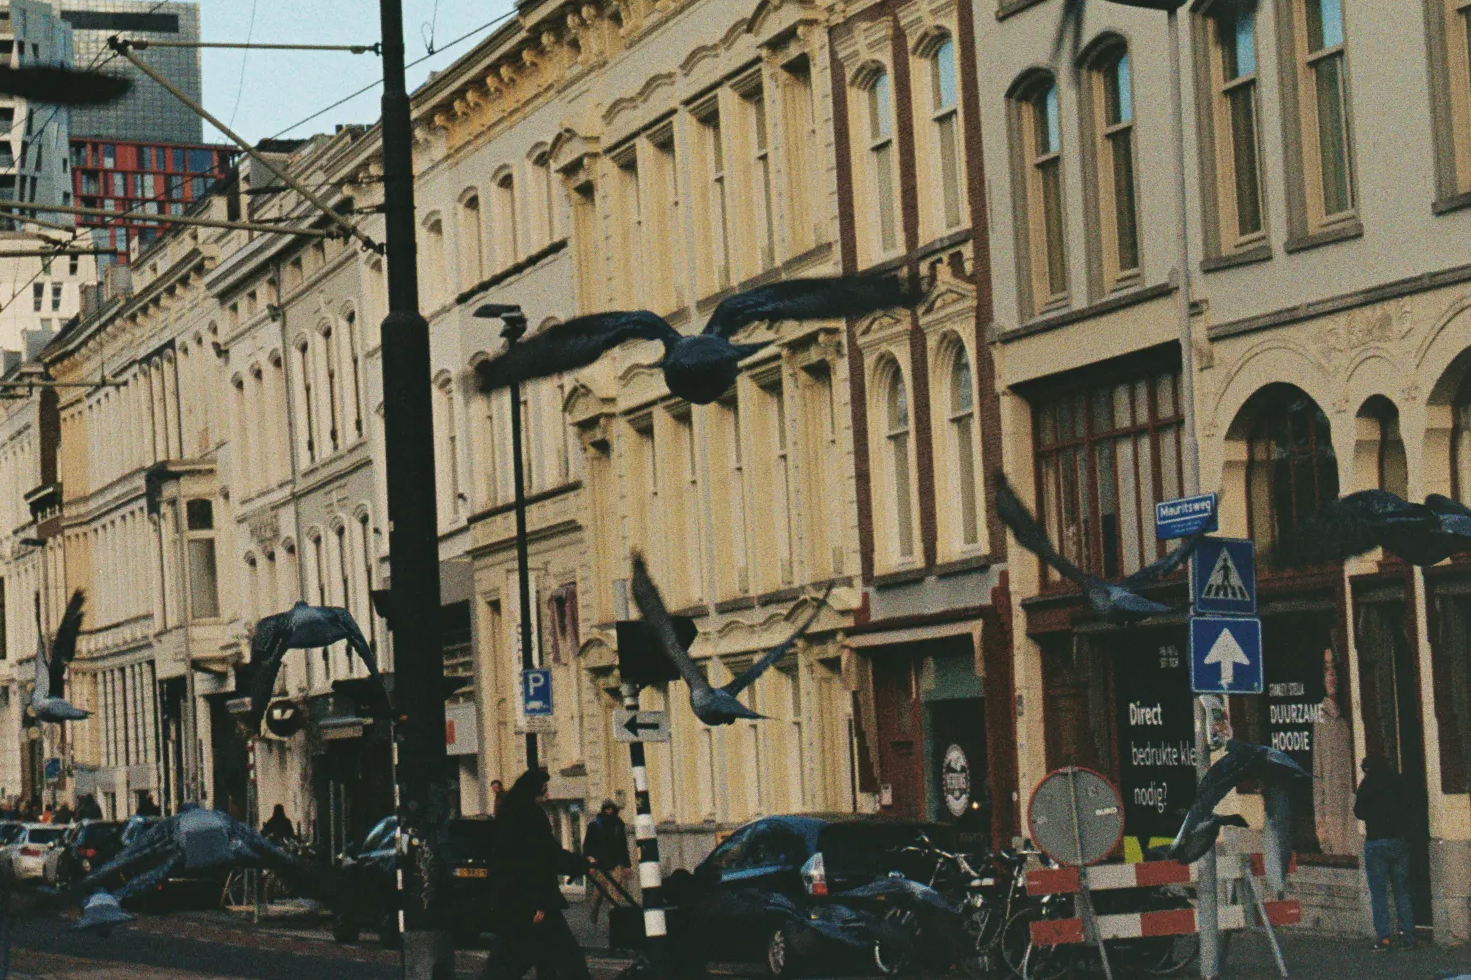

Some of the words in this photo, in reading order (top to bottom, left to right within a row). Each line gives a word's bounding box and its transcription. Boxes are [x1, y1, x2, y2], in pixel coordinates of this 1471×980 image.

[1160, 500, 1211, 517] Mauritsweg
[529, 673, 545, 696] P
[1129, 700, 1163, 726] Direct
[1270, 703, 1325, 724] DUURZAME
[1271, 731, 1310, 751] HOODIE
[1131, 740, 1178, 766] bedrukte
[1134, 781, 1167, 814] nodig?
